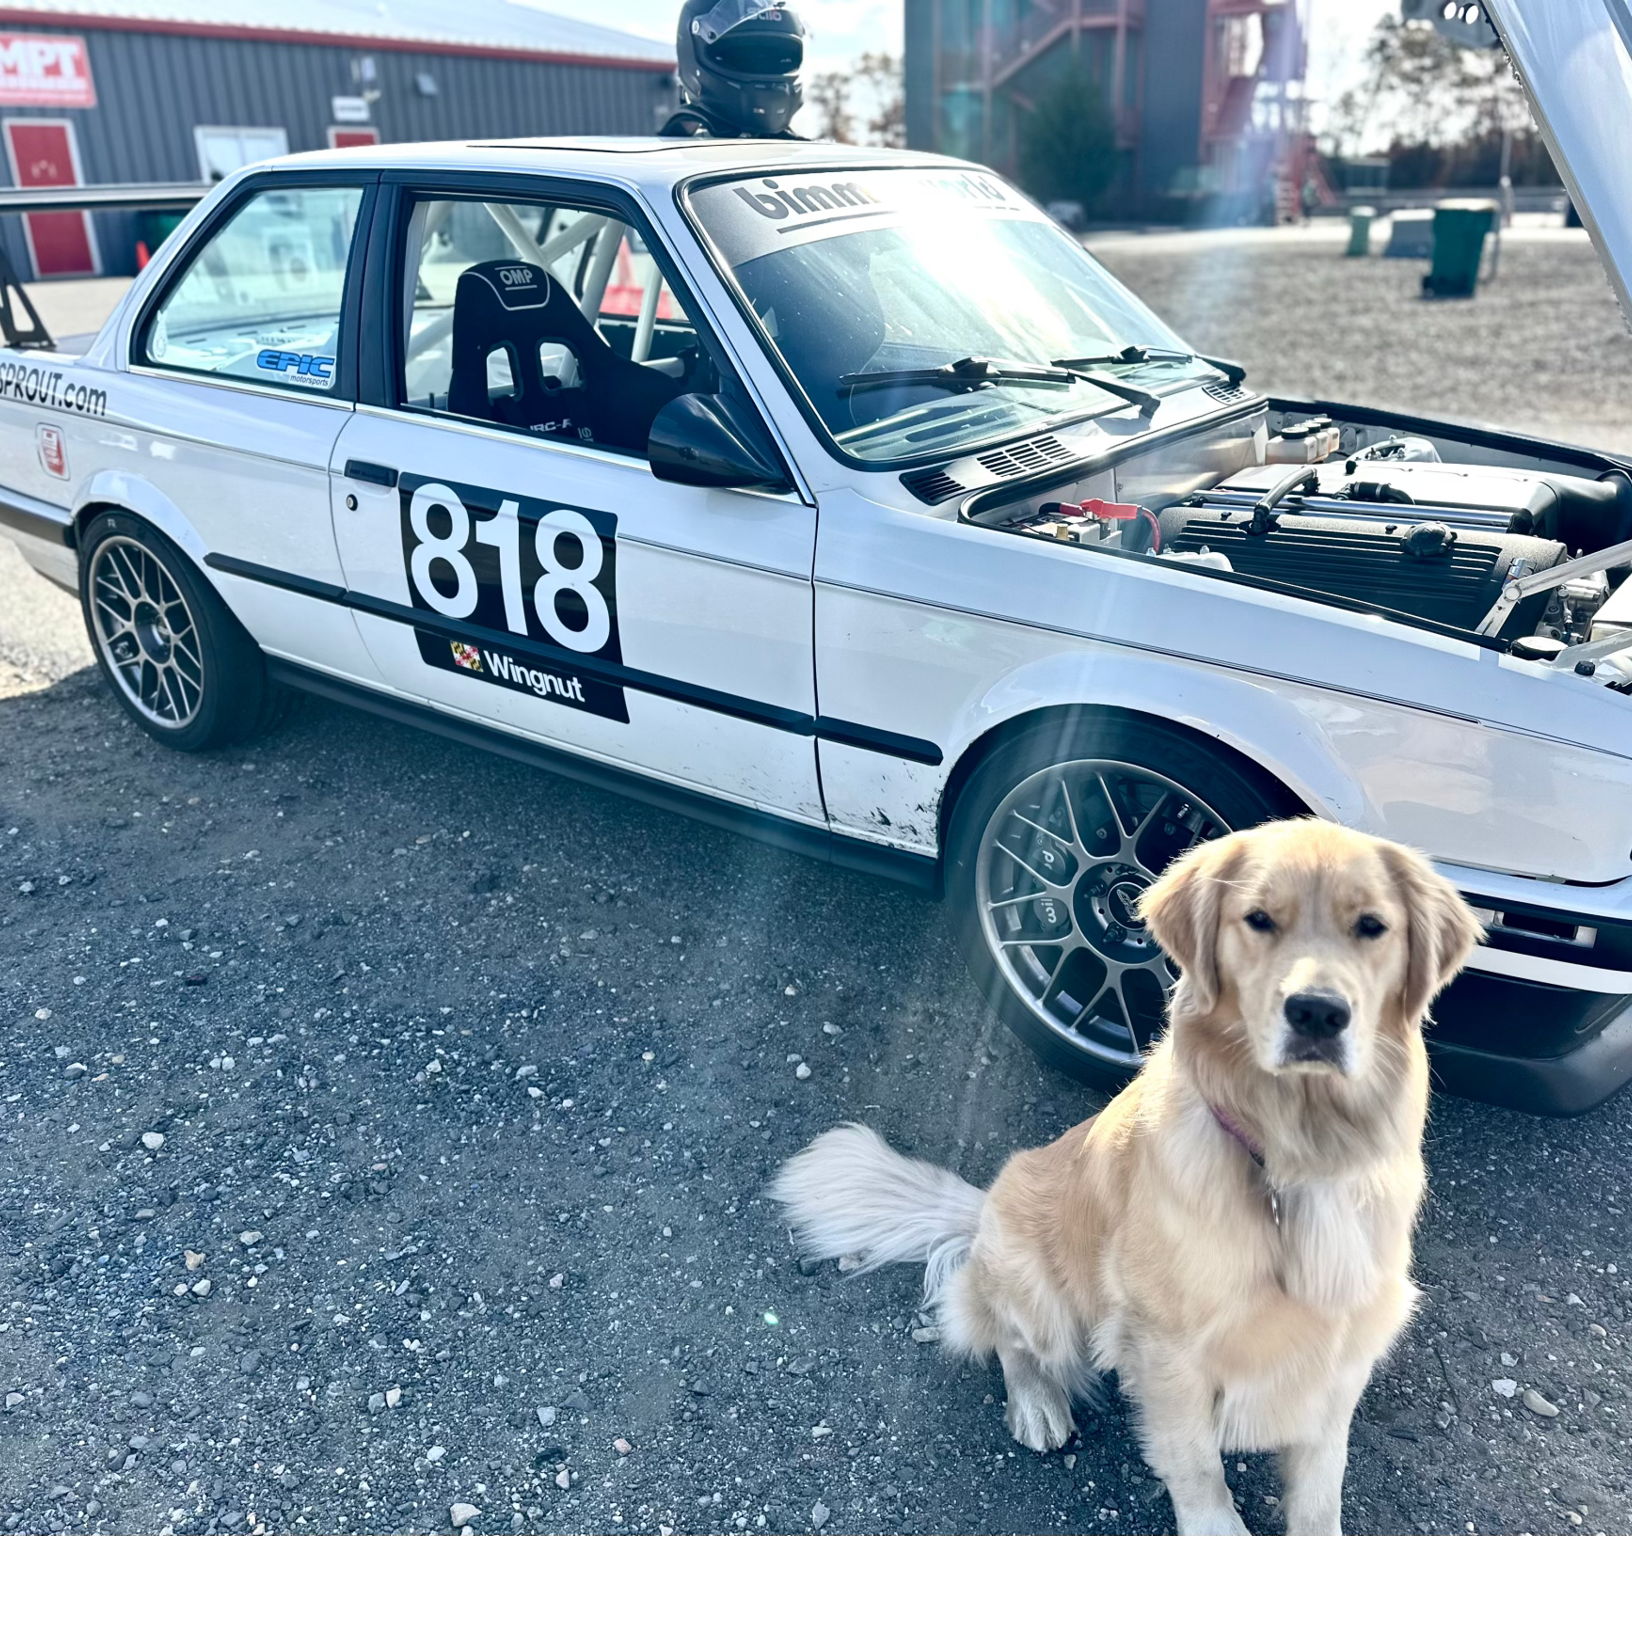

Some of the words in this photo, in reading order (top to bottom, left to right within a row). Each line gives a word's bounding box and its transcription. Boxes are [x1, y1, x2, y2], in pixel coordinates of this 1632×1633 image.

[500, 269, 533, 285] OMP
[257, 349, 336, 379] EPIC
[290, 375, 329, 386] motorsports
[410, 483, 610, 653] 818
[483, 650, 585, 702] Wingnut
